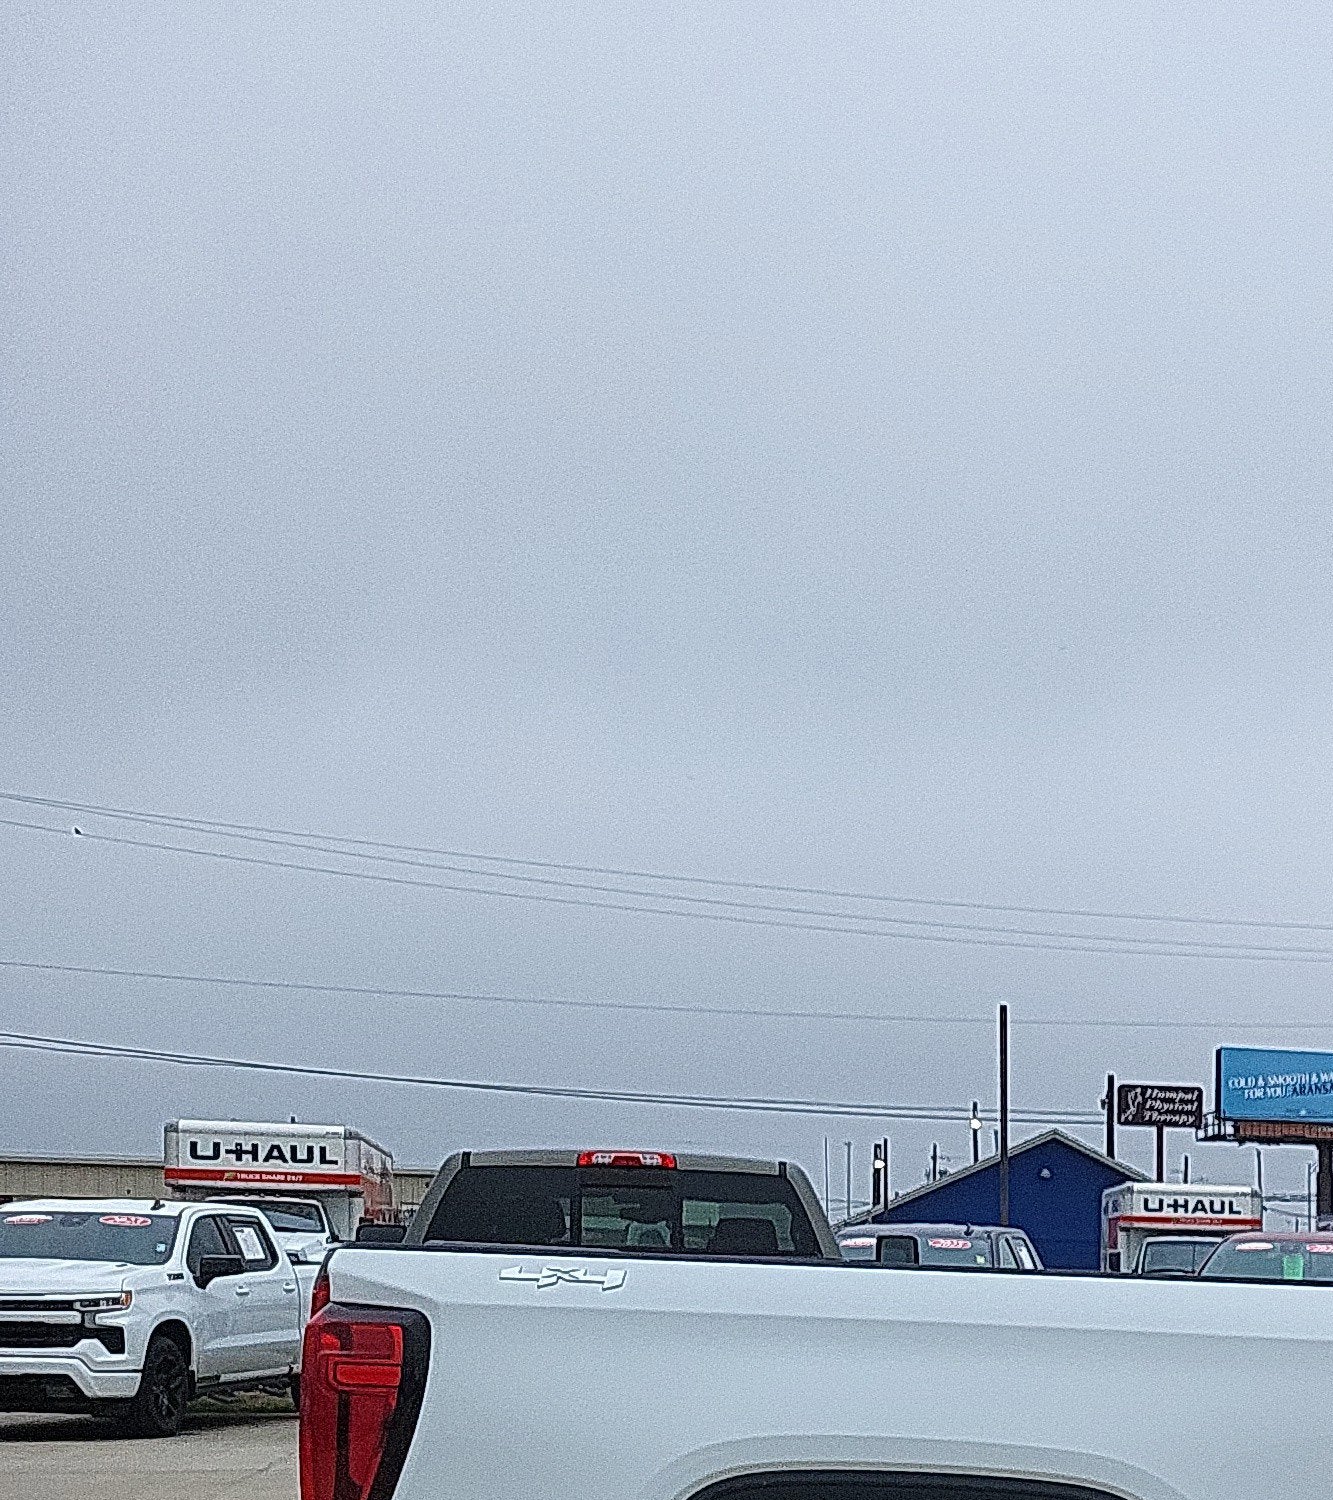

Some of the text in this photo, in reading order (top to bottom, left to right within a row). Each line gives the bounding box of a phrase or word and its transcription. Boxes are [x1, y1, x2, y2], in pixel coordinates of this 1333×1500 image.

[1244, 1088, 1264, 1099] FOR
[189, 1140, 339, 1165] U-HAUL
[1143, 1197, 1242, 1215] U-HAUL
